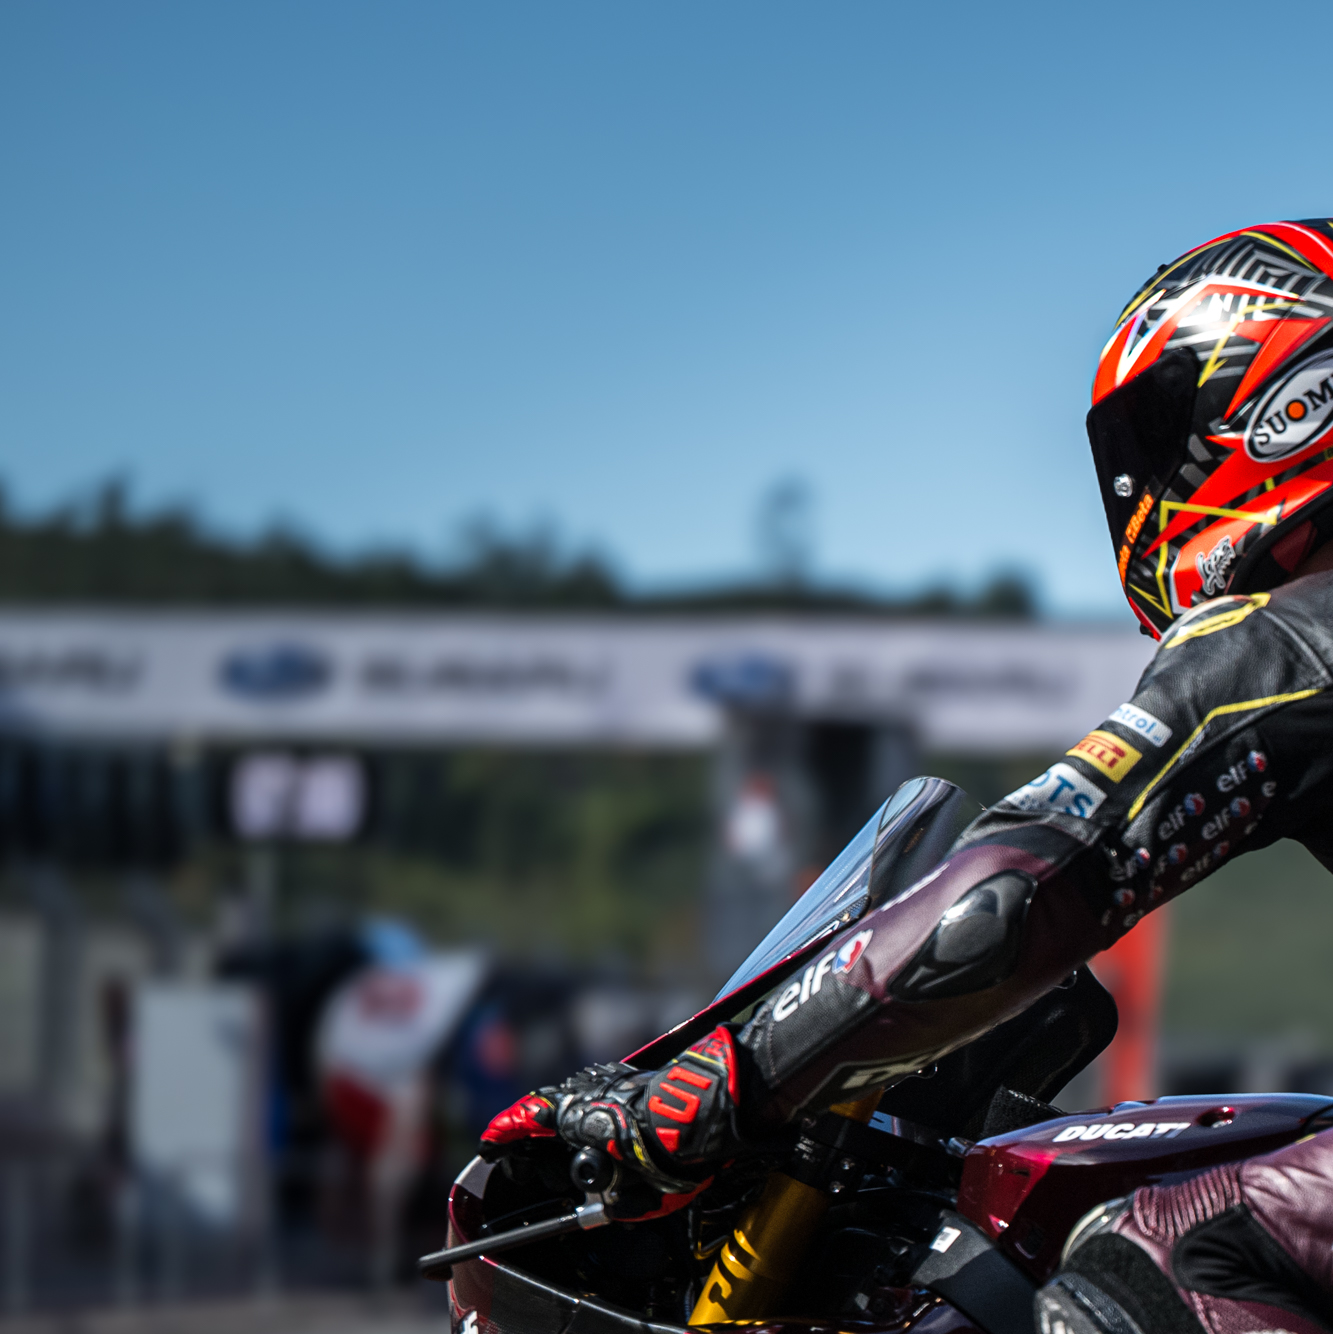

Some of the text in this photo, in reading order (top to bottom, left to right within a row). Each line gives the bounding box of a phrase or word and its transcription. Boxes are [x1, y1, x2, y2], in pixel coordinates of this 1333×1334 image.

[1216, 760, 1249, 792] elf
[1158, 805, 1187, 841] elf
[1202, 807, 1231, 840] elf
[772, 951, 835, 1022] elf
[1052, 1122, 1192, 1144] DUCATI
